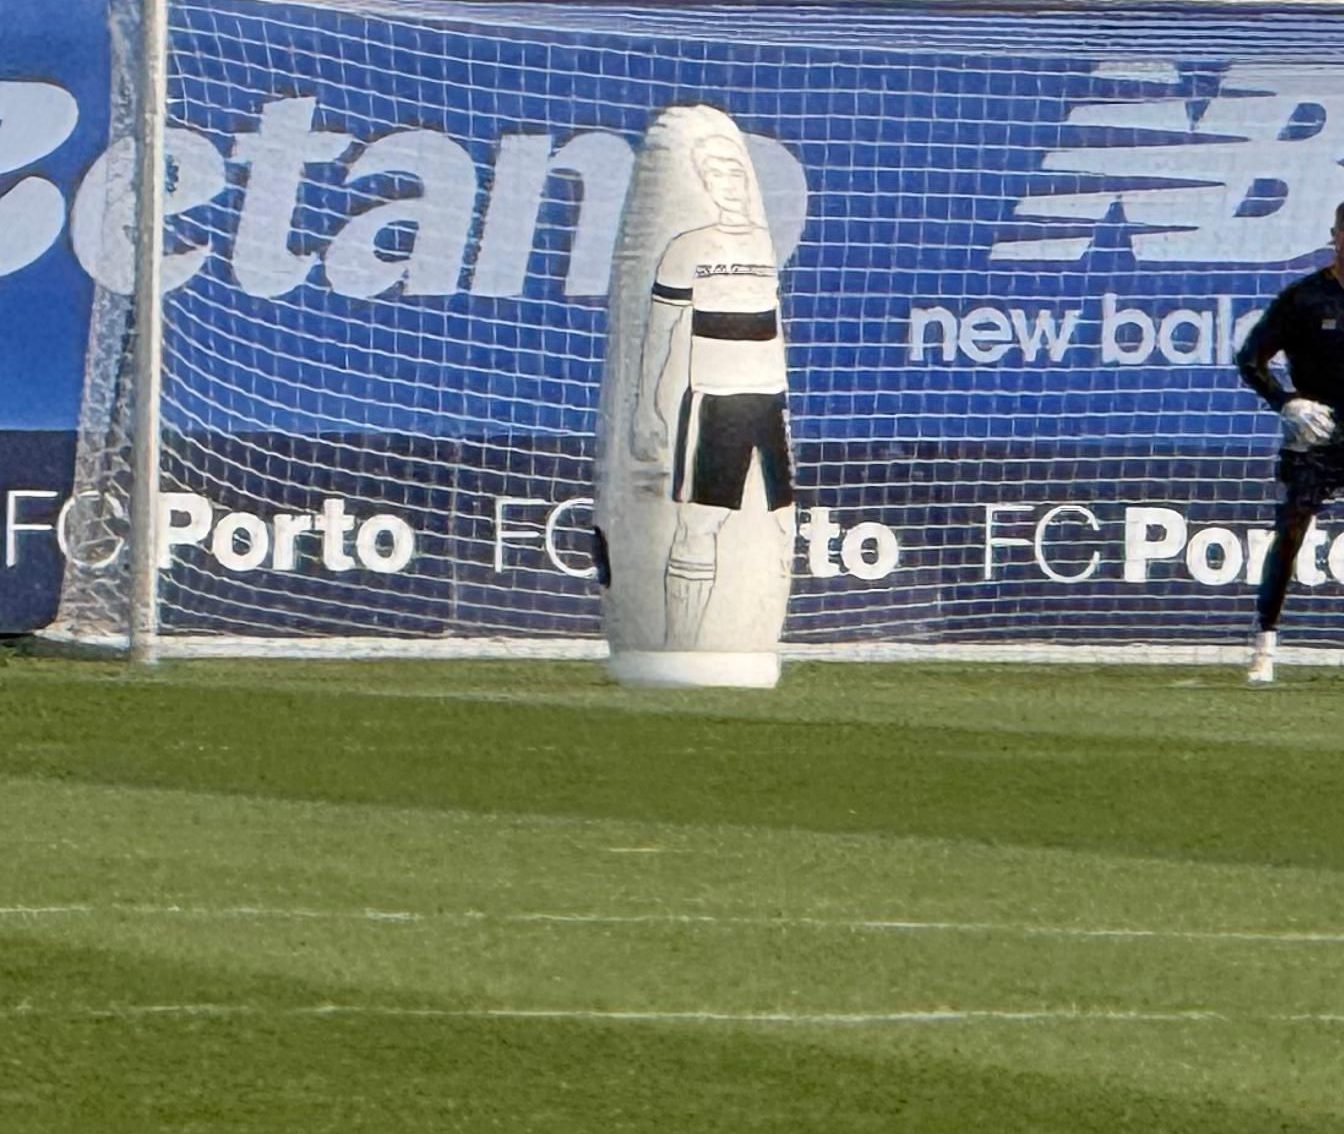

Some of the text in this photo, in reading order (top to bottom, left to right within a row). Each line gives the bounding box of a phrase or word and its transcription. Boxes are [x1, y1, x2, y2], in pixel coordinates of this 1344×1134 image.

[0, 80, 808, 299] etan
[908, 304, 1084, 364] new
[6, 489, 416, 573] FC Porto
[985, 504, 1101, 584] FC
